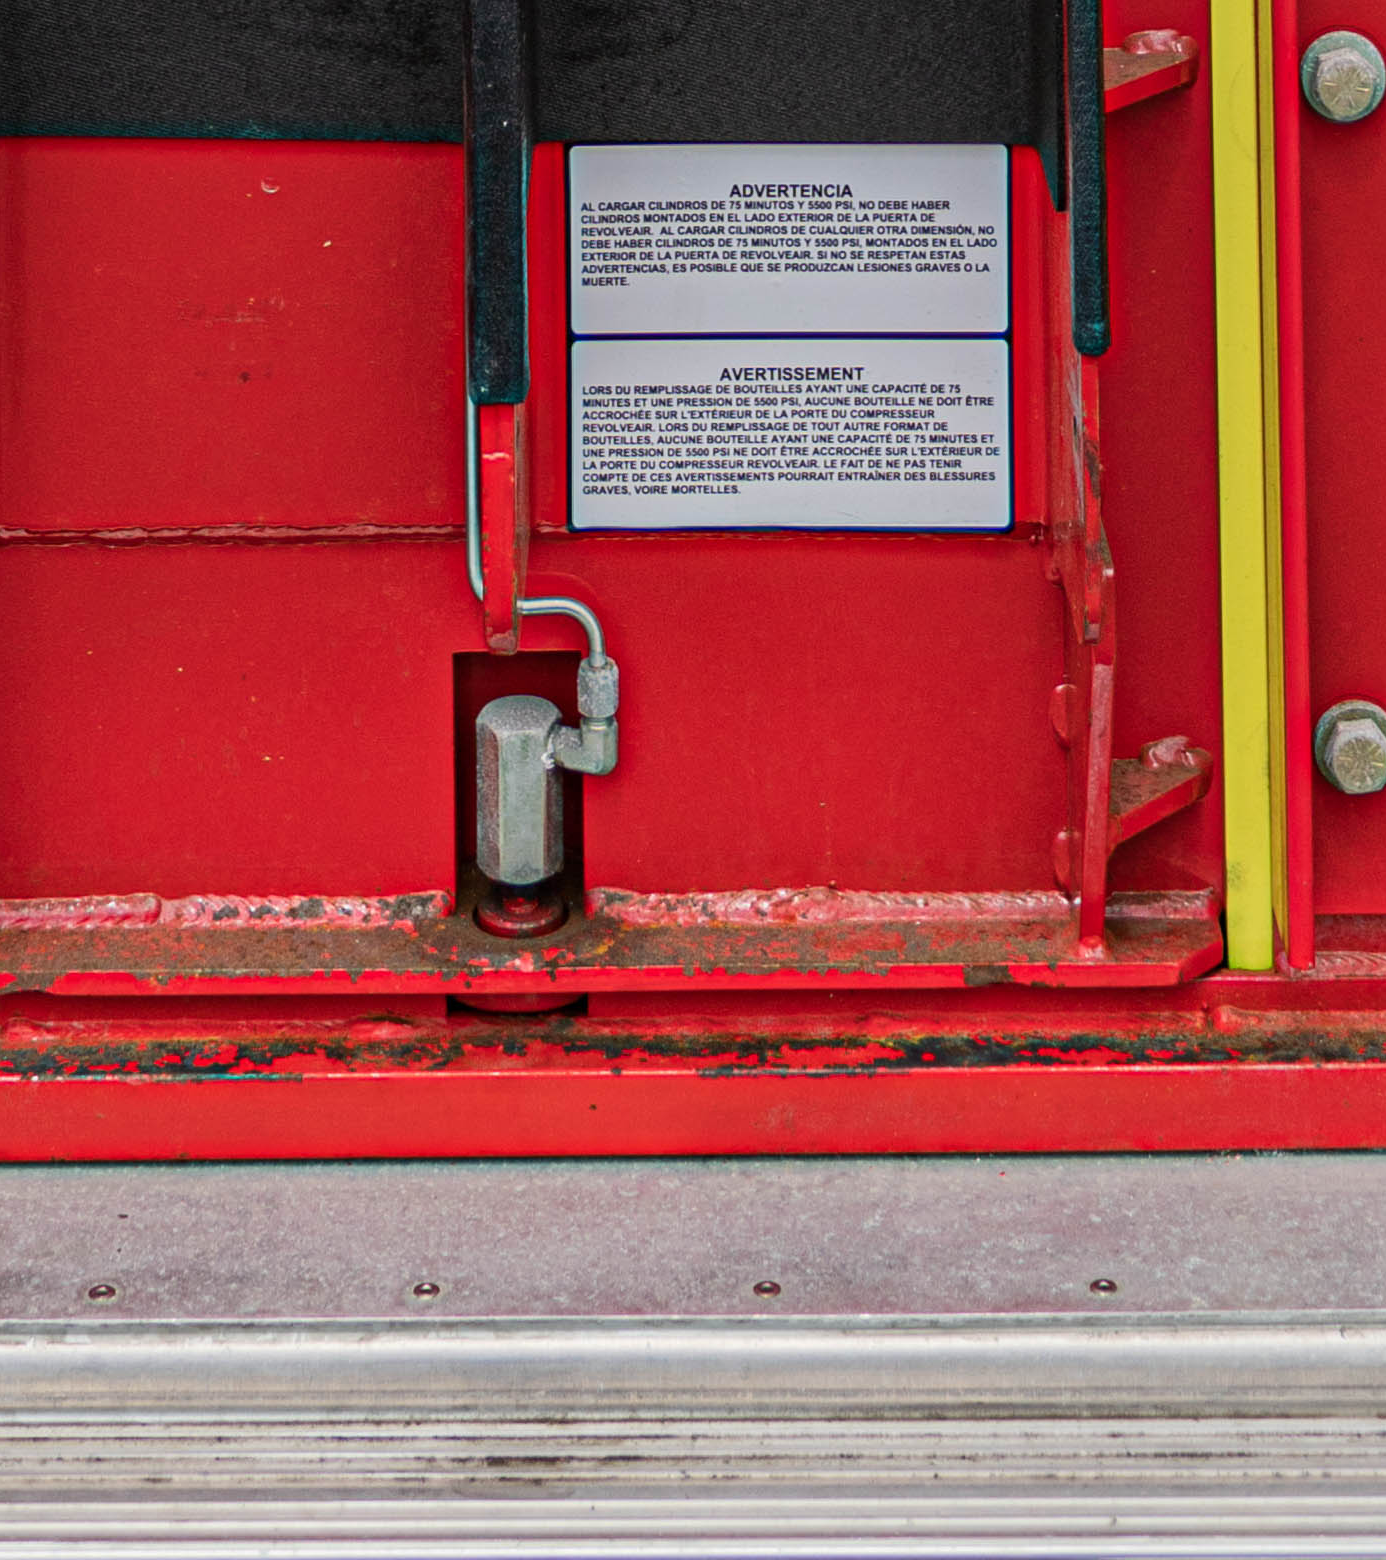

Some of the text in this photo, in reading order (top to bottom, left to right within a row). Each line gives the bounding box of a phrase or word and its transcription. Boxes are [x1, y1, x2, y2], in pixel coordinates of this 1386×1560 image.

[730, 184, 853, 198] ADVERTENCIA
[581, 201, 950, 212] AL CARGAR CILINDROS DE 75 MINUTOS Y 5500 PSI, NO DEBE HABER
[720, 367, 864, 381] AVERTISSEMENT
[583, 384, 961, 395] LORS DU REMPLISSAGE DE BOUTEILLES AYANT UNE CAPACITÉ DE 75
